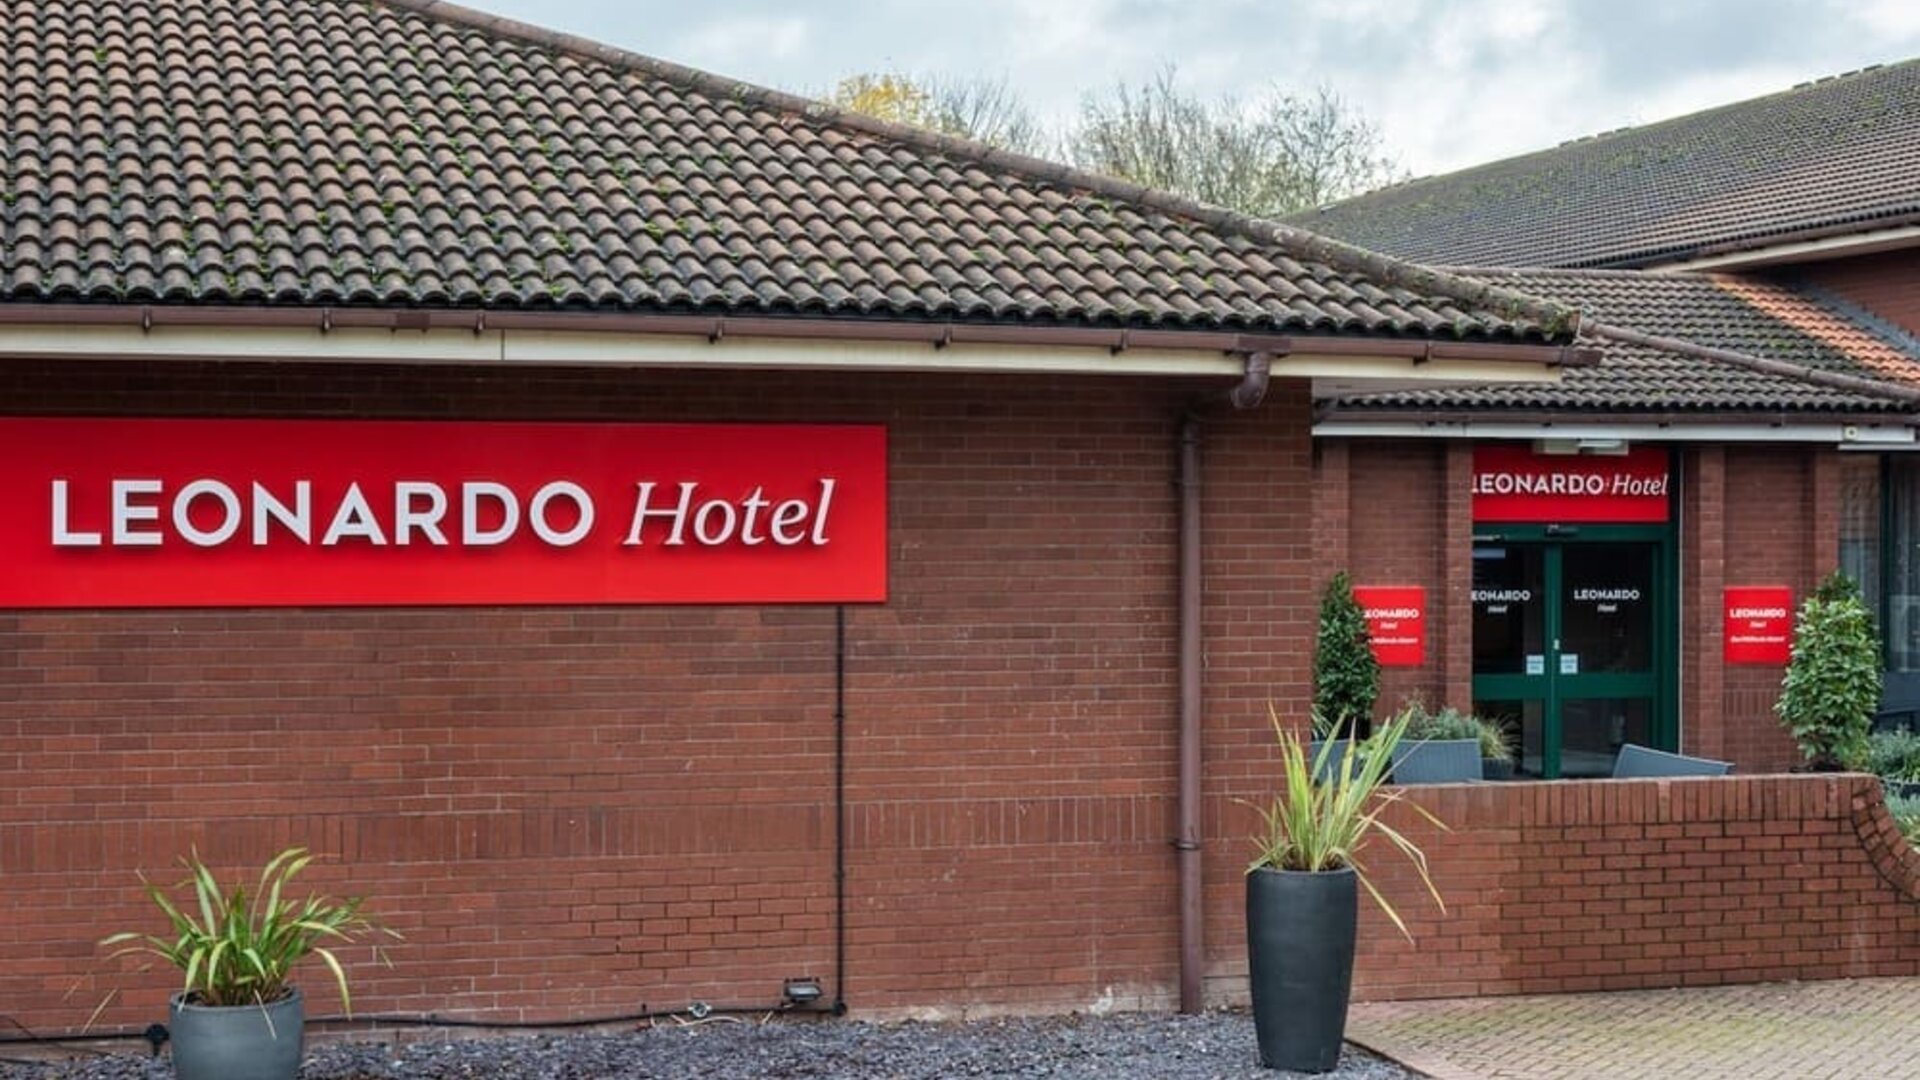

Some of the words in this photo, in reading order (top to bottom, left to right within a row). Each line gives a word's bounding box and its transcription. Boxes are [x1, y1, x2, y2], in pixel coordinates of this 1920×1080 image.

[1611, 473, 1669, 495] Hotel
[52, 479, 595, 547] LEONARDO
[623, 478, 835, 546] Hotel
[1471, 589, 1531, 601] EONARDO
[1573, 589, 1640, 600] LEONARDO
[1363, 608, 1420, 619] EONARDO
